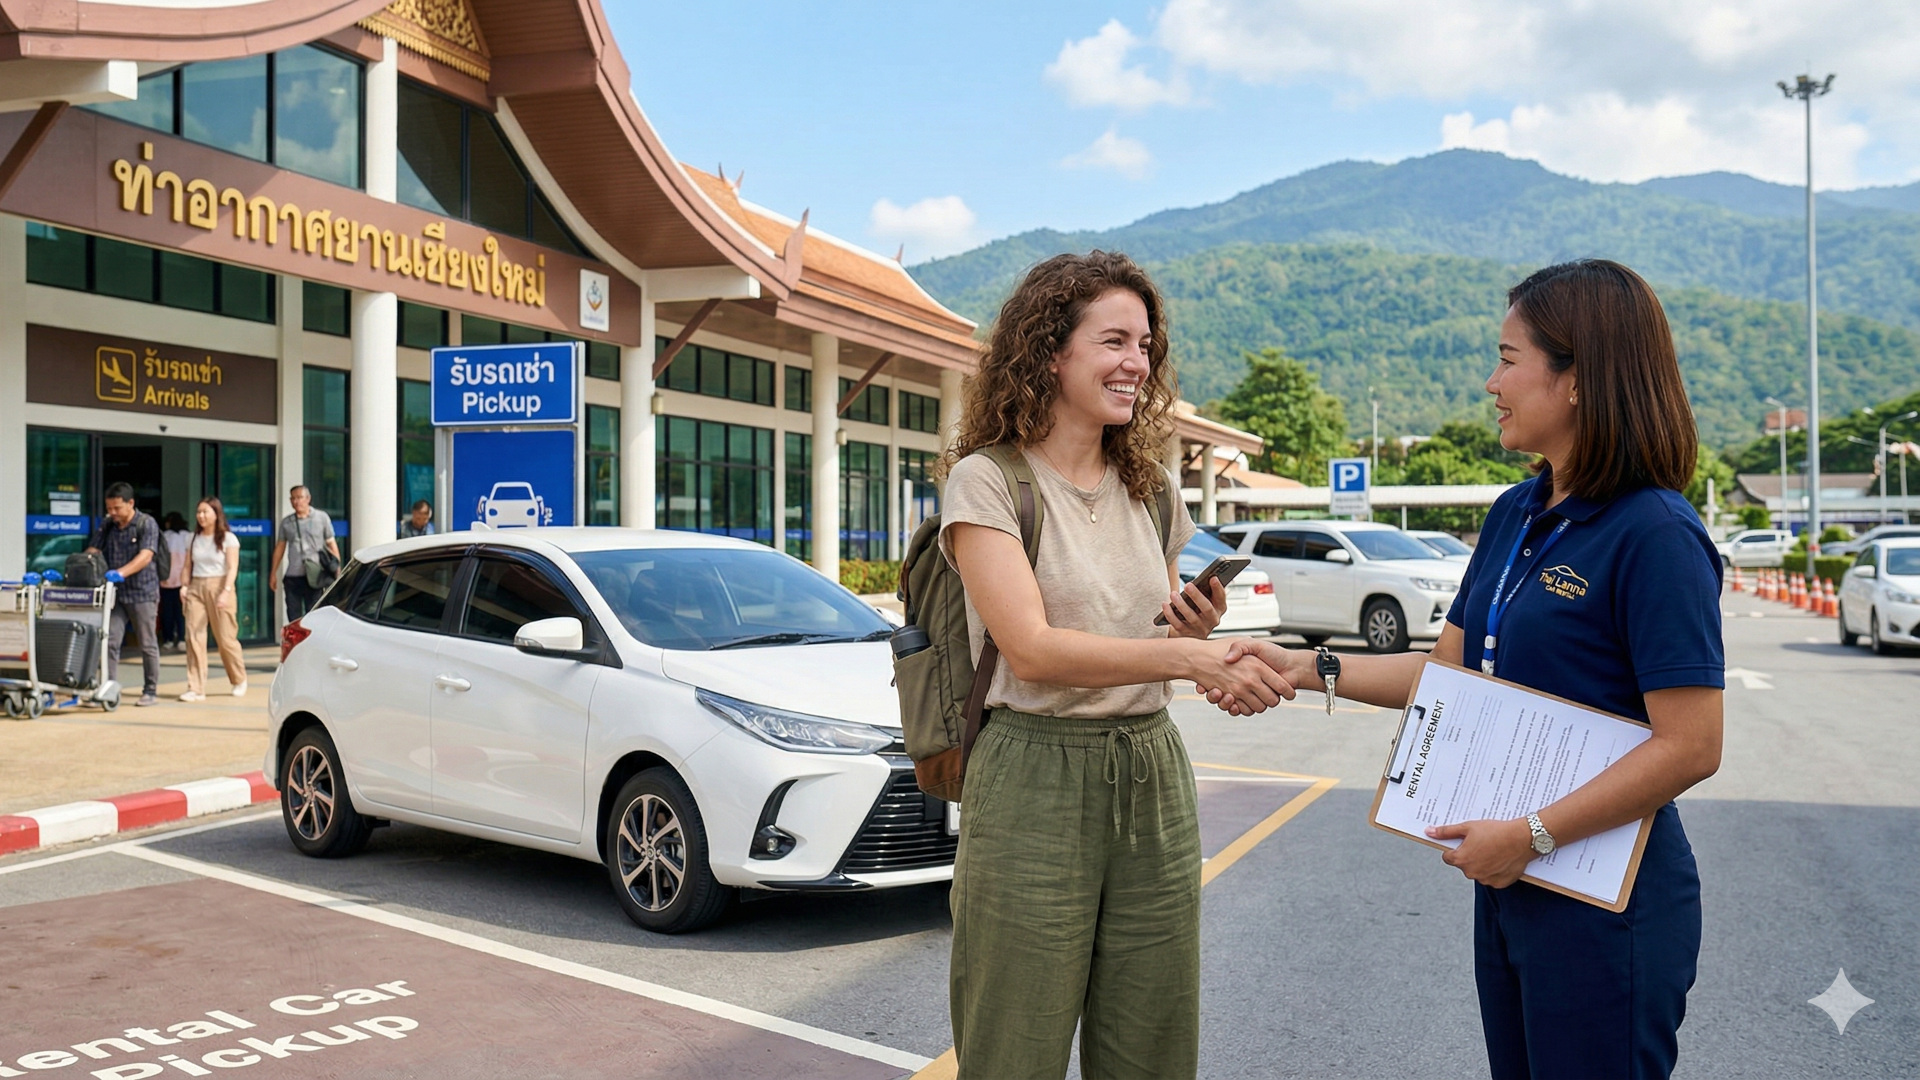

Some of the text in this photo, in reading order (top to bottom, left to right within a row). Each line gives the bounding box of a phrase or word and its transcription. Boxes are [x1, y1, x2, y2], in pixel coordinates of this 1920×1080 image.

[114, 141, 546, 307] ท่าอากาศยานเชียงใหม่
[450, 352, 555, 387] รับรถเช่า
[143, 384, 210, 411] Arrivals
[462, 390, 542, 419] Pickup
[1339, 464, 1360, 489] P
[1555, 576, 1587, 597] Lanna
[1406, 761, 1426, 799] RENTAL
[1419, 699, 1445, 760] AGREEMENT
[269, 980, 417, 1016] Car
[90, 1016, 419, 1080] Pickup
